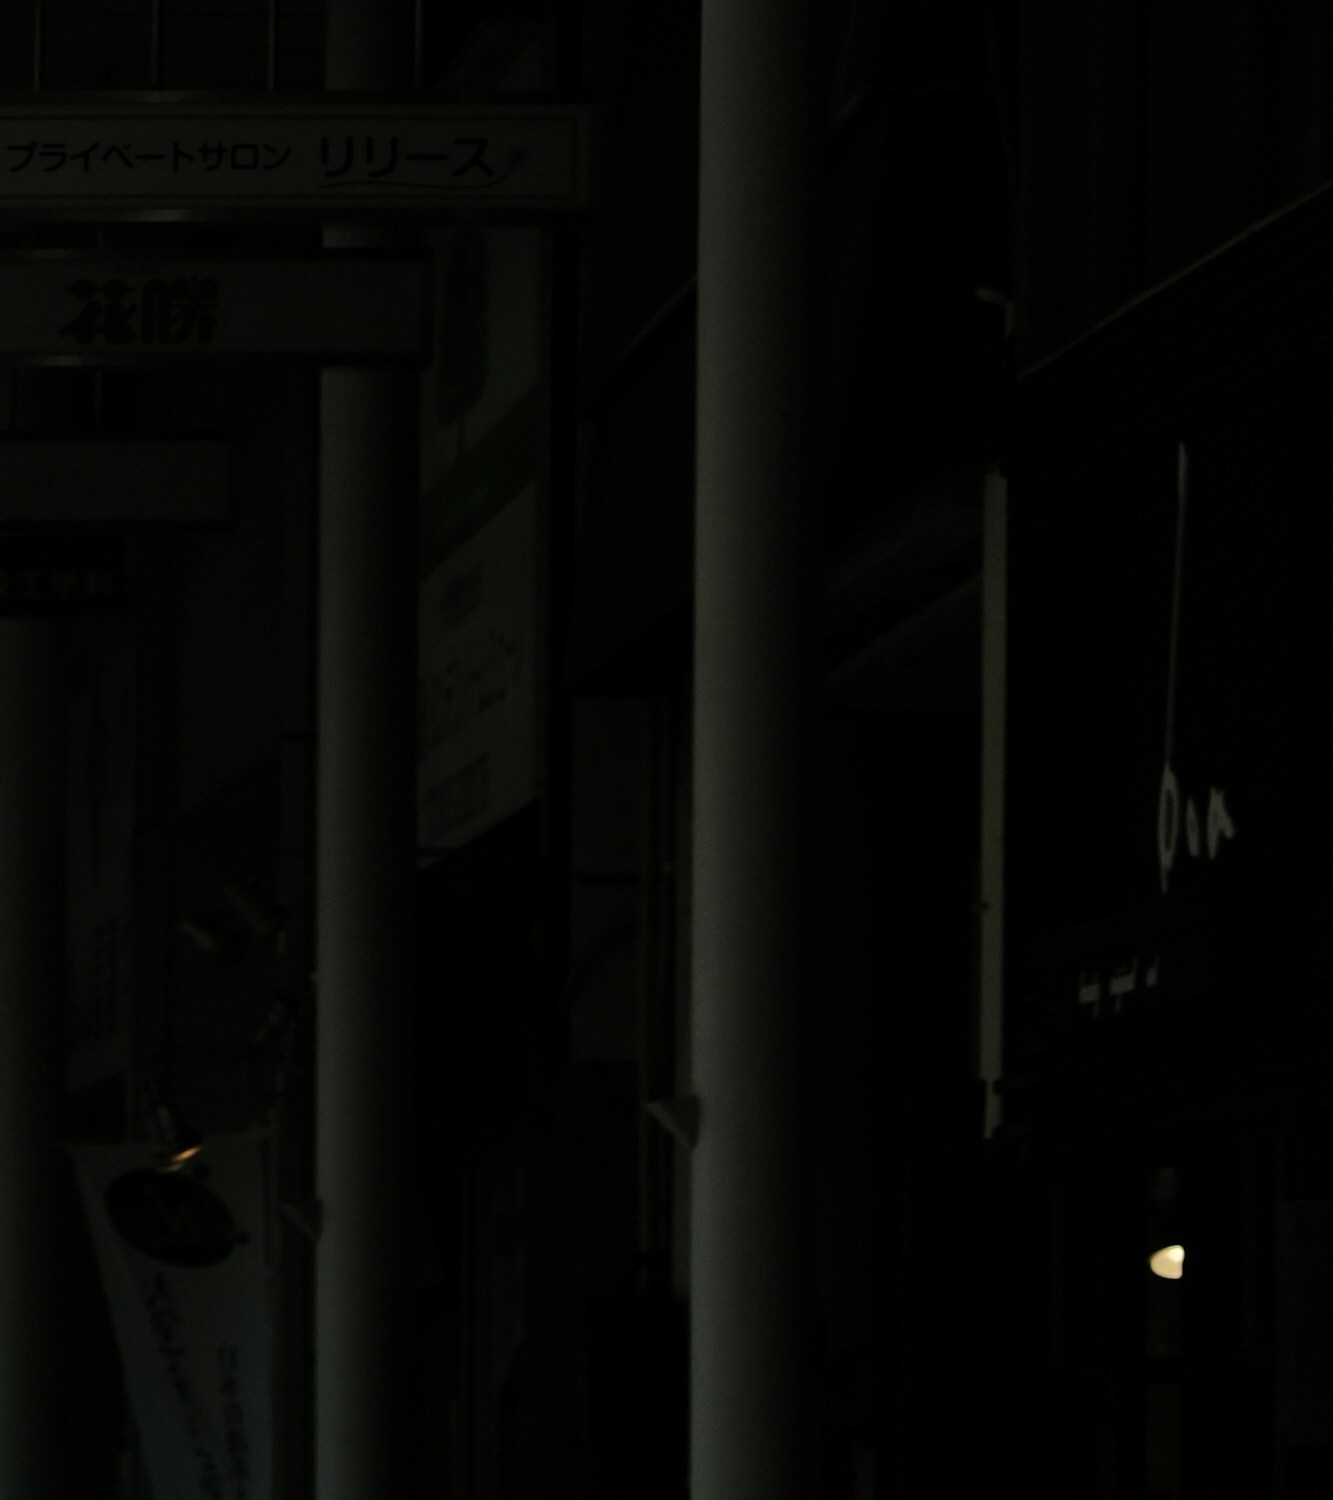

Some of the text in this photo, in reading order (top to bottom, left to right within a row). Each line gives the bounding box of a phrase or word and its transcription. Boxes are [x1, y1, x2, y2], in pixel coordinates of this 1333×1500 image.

[8, 136, 496, 178] プライベートサロン リリース
[60, 274, 219, 345] 花勝
